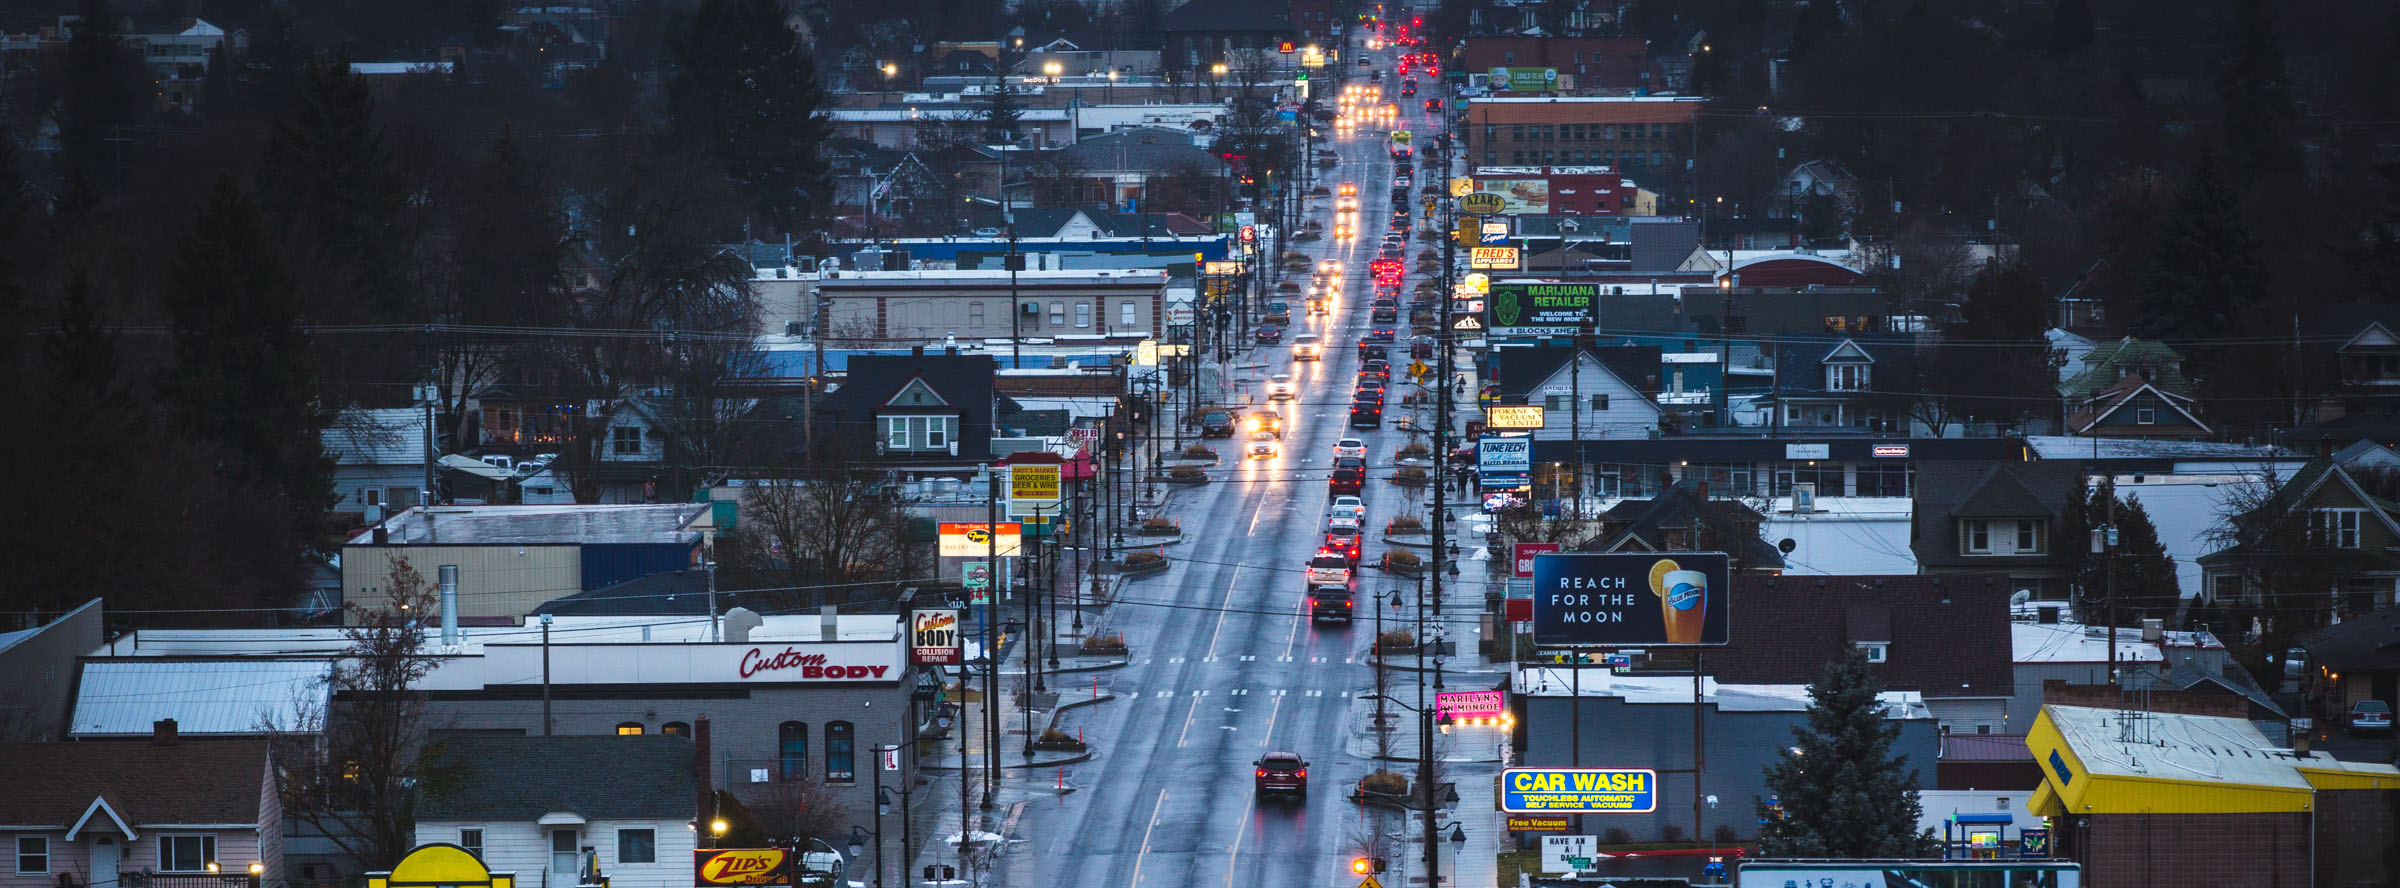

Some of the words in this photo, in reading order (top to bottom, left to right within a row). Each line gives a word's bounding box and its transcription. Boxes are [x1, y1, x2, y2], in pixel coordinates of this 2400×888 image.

[1475, 248, 1515, 258] FRED'S
[1528, 285, 1596, 296] MARIJUANA
[1534, 296, 1590, 307] RETAILER
[1482, 442, 1527, 453] TUNETECH
[1560, 577, 1626, 589] REACH
[1551, 594, 1589, 606] FOR
[1599, 594, 1635, 606] THE
[916, 612, 956, 633] Custom
[1563, 611, 1623, 623] MOON
[916, 630, 954, 647] BODY
[916, 648, 955, 656] COLLISION
[740, 647, 828, 679] Custom
[802, 665, 889, 679] BODY
[1440, 693, 1499, 704] MARILYN'S
[1440, 704, 1454, 713] ON
[1457, 703, 1500, 712] MONROE
[1514, 773, 1566, 791] CAR
[1572, 773, 1644, 791] WASH
[1523, 794, 1579, 802] TOUCHLESS
[1581, 794, 1635, 802] AUTOMATIC
[1509, 818, 1530, 827] Free
[1531, 818, 1567, 827] Vacuum
[714, 854, 772, 880] ZIP'S
